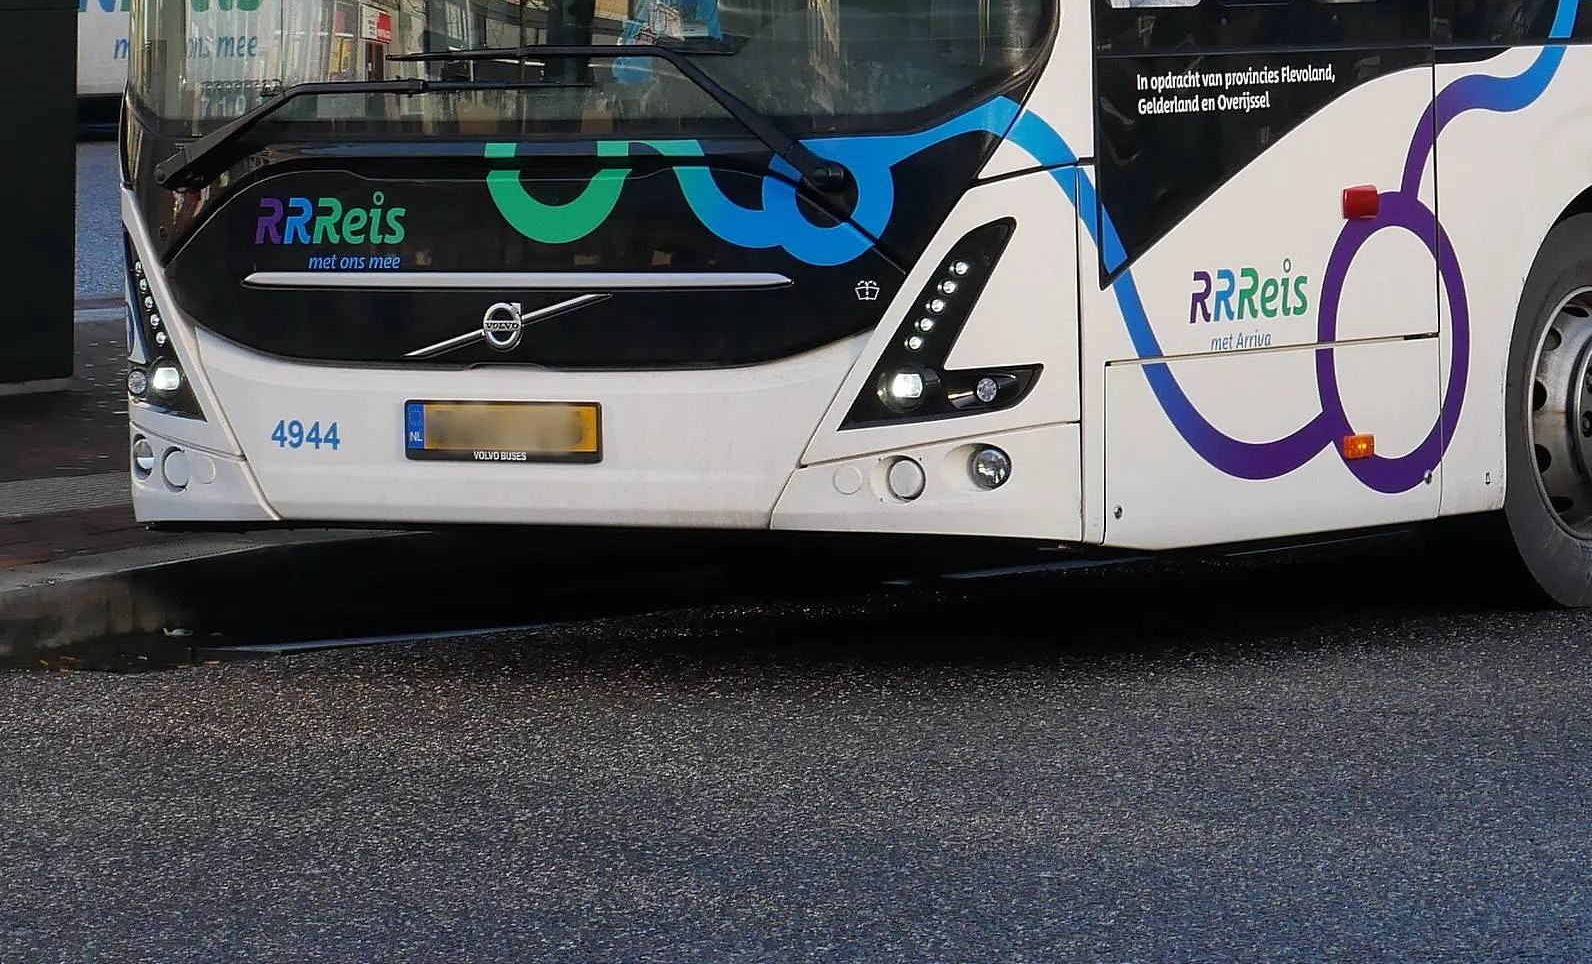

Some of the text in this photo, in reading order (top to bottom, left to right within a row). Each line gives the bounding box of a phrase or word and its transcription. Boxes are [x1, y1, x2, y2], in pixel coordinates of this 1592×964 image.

[216, 36, 258, 57] mee
[1137, 64, 1335, 93] In opdracht van provincies Flevoland,
[1138, 91, 1270, 115] Gelderland en Overijssel
[255, 191, 407, 245] RRReis
[308, 254, 401, 269] met ons mee
[1189, 258, 1308, 324] RRReis
[1210, 329, 1271, 351] met Arriva
[271, 419, 340, 451] 4944
[409, 431, 423, 442] NL
[473, 450, 527, 461] VOLVO BUSES
